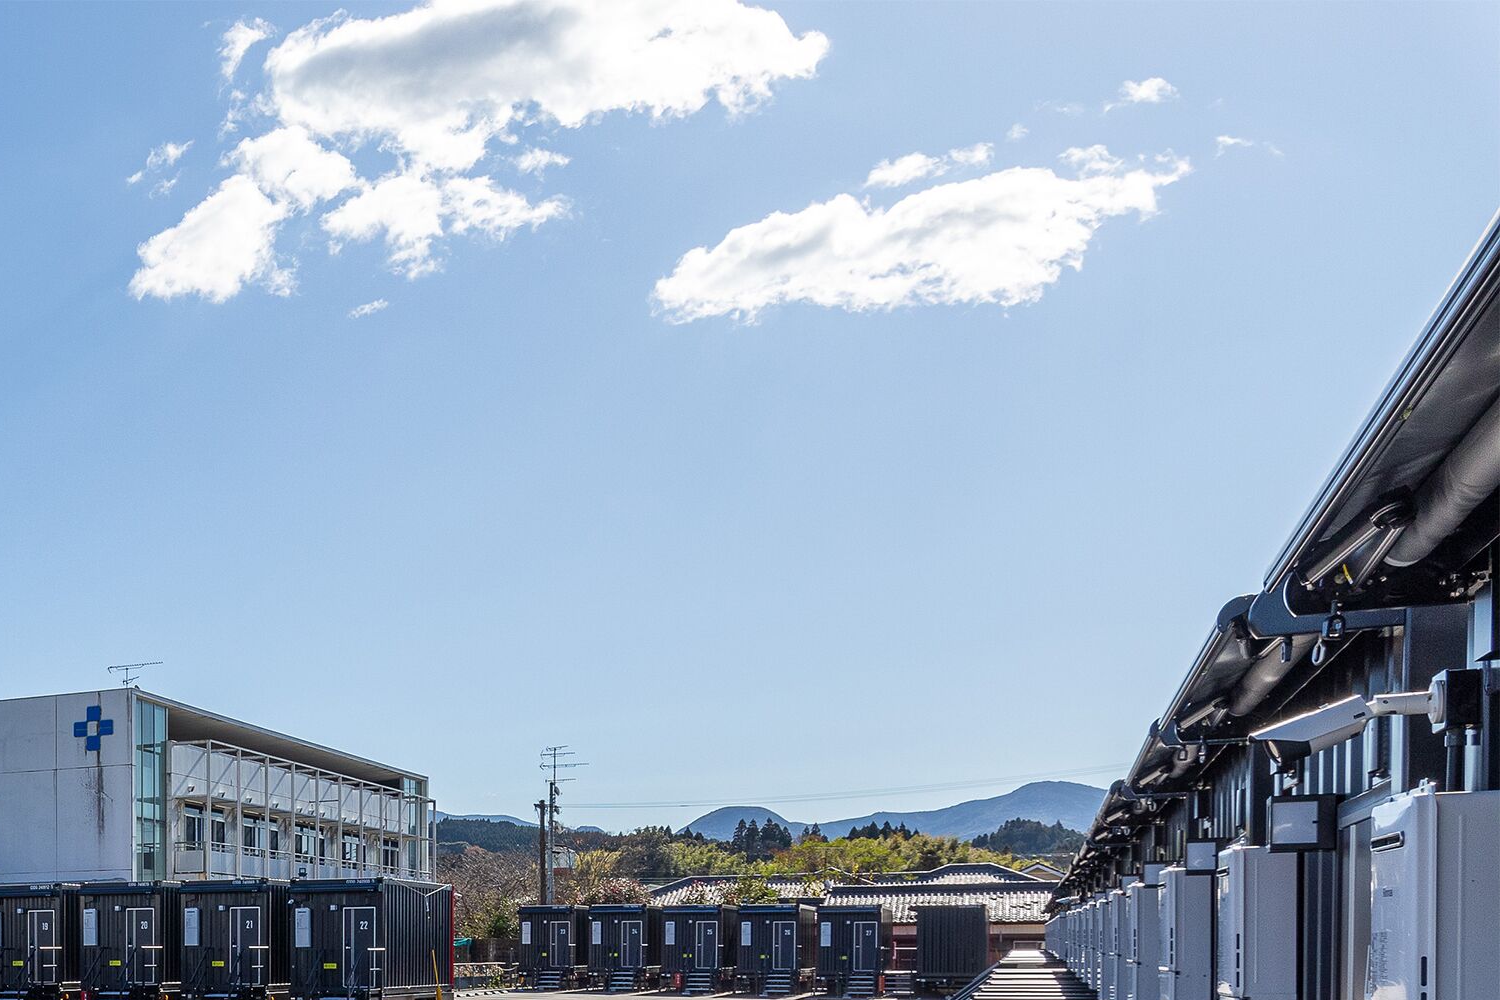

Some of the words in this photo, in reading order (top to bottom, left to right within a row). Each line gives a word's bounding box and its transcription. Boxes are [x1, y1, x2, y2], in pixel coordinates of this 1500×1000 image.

[42, 922, 49, 931] 19
[140, 921, 149, 930] 20
[245, 920, 254, 929] 21
[359, 920, 369, 930] 22
